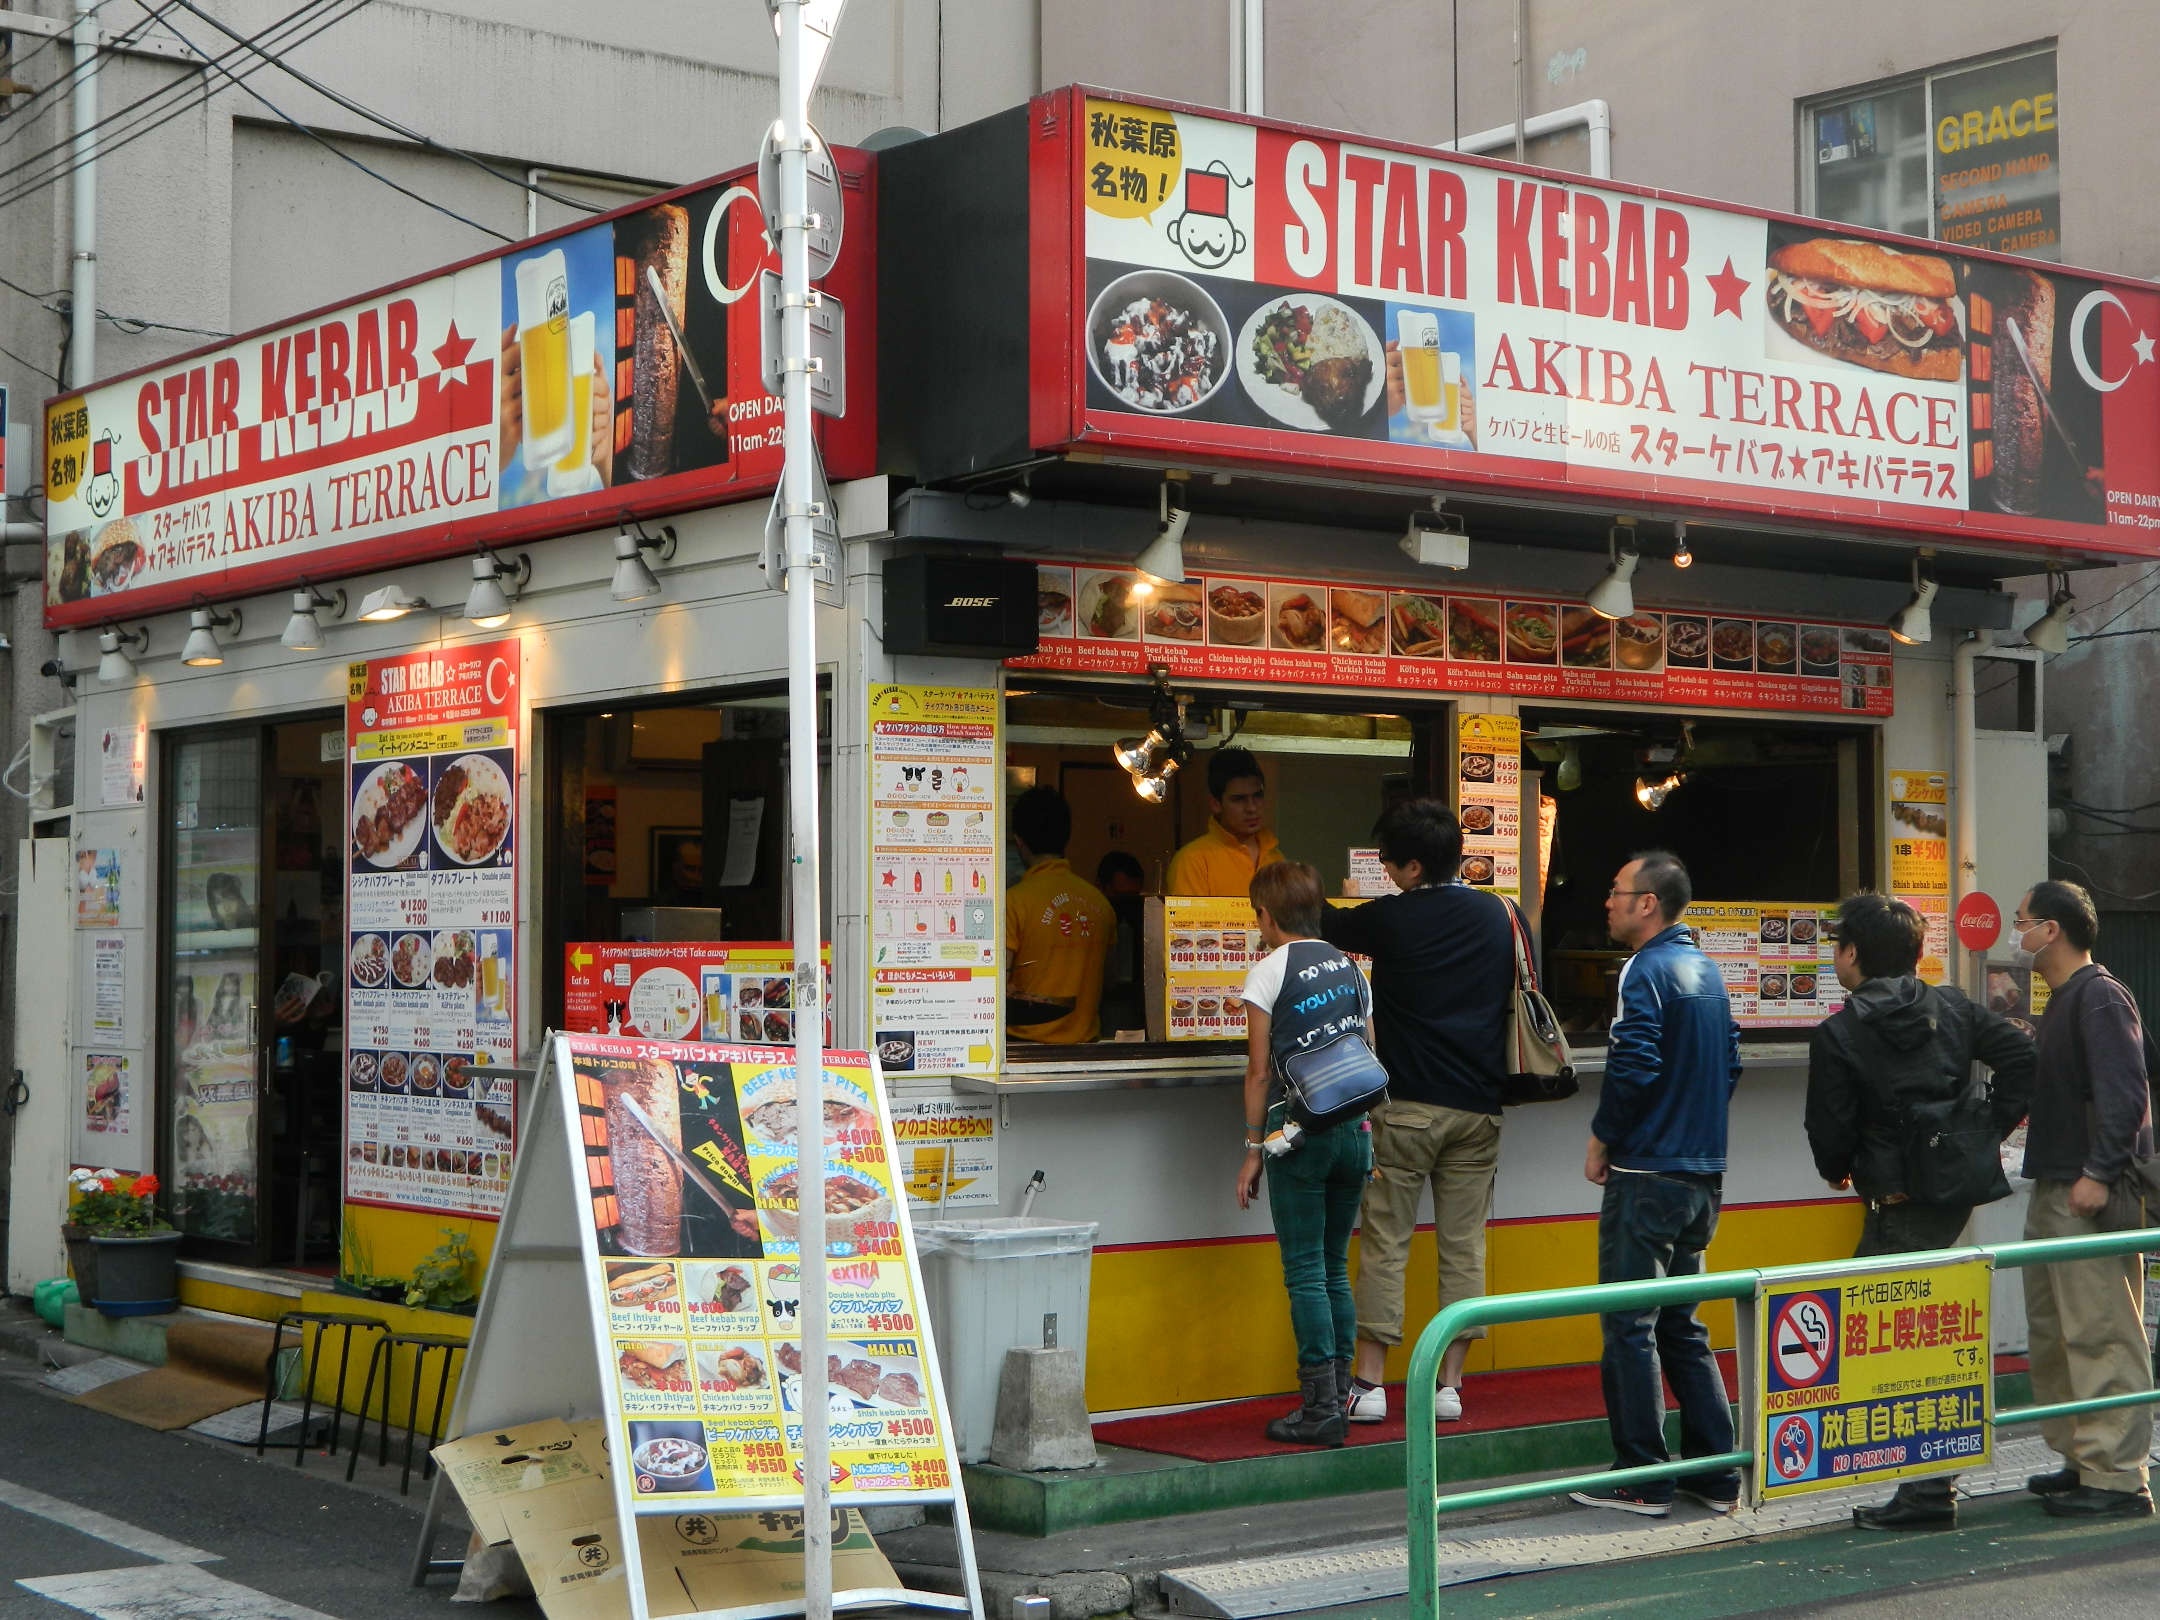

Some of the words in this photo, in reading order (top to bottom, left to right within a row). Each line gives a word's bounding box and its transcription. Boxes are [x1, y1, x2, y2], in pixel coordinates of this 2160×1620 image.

[1937, 93, 2055, 153] GRACE
[1090, 111, 1178, 160] 秋葉原
[1940, 163, 2002, 192] SECOND
[2005, 152, 2050, 177] HAND
[1941, 193, 2008, 221] CAMERA
[1942, 221, 1982, 242] VIDEO
[1987, 208, 2043, 233] CAMERA
[1284, 139, 1468, 300] STAR
[1498, 177, 1690, 331] KEBAB
[2001, 229, 2056, 253] CAMERA
[137, 357, 240, 497] STAR
[261, 297, 419, 456] KEBAB
[1483, 331, 1676, 415] AKIBA
[1689, 361, 1960, 452] TERRACE
[729, 398, 761, 423] OPEN
[51, 406, 88, 446] 秋葉原
[1488, 414, 1621, 455] ケバブと生ビールの店
[221, 483, 316, 556] AKIBA
[328, 440, 492, 527] TERRACE
[2107, 490, 2132, 504] OPEN
[944, 597, 1000, 607] BOSE
[1056, 646, 1073, 655] pita
[1078, 646, 1095, 655] Beef
[1097, 647, 1119, 656] kebab
[1121, 650, 1139, 658] wrap
[1144, 646, 1163, 654] Beef
[1165, 647, 1188, 655] kebab
[1147, 654, 1179, 664] Turkish
[1181, 655, 1204, 664] bread
[1208, 653, 1233, 663] Chicken
[1234, 656, 1252, 664] kebab
[1253, 657, 1266, 666] pita
[1269, 657, 1294, 667] Chicken
[1295, 659, 1313, 668] kebab
[1314, 662, 1327, 670] wrap
[1331, 656, 1363, 666] Chicken
[1365, 658, 1386, 667] kebab
[381, 666, 406, 695] STAR
[409, 660, 445, 690] KEBAB
[1334, 665, 1363, 674] Turkish
[1365, 667, 1386, 675] bread
[1422, 667, 1435, 676] pita
[387, 693, 422, 714] AKIBA
[424, 685, 482, 708] TERRACE
[1496, 761, 1518, 770] ¥650
[1496, 776, 1518, 785] ¥550
[1496, 827, 1518, 837] ¥500
[1895, 844, 1912, 857] 1串
[1914, 841, 1946, 861] ¥500
[1496, 866, 1517, 876] ¥650
[1913, 880, 1930, 889] kebab
[400, 899, 427, 911] ¥1200
[1298, 965, 1319, 983] DO
[1318, 956, 1351, 973] WHA
[1294, 993, 1328, 1014] YOU
[1327, 984, 1357, 1001] LOV
[1339, 1015, 1366, 1032] WHA
[572, 1042, 597, 1051] STAR
[600, 1045, 632, 1055] KEBAB
[742, 1070, 774, 1096] BEEF
[835, 1076, 869, 1104] PITA
[840, 1147, 885, 1163] ¥500
[757, 1161, 799, 1193] CHICKE
[859, 1170, 886, 1197] PITA
[854, 1222, 899, 1238] ¥500
[857, 1240, 902, 1257] ¥400
[832, 1260, 880, 1281] EXTRA
[828, 1291, 854, 1299] Double
[881, 1292, 895, 1300] pita
[1845, 1279, 1932, 1307] 千代田区内は
[829, 1299, 903, 1314] ダブルケバブ
[612, 1313, 630, 1322] Beef
[690, 1315, 707, 1323] Beef
[711, 1314, 736, 1323] kebab
[739, 1316, 760, 1325] wrap
[867, 1314, 914, 1331] ¥500
[1845, 1298, 1984, 1358] 路上喫煙禁止
[867, 1343, 915, 1357] HALAL
[1953, 1346, 1984, 1367] です。
[624, 1392, 660, 1402] Chicken
[702, 1393, 729, 1401] Chicken
[732, 1393, 754, 1401] kebab
[755, 1395, 773, 1404] wrap
[1767, 1391, 1784, 1410] NO
[1786, 1386, 1840, 1407] SMOKING
[858, 1409, 878, 1417] Shish
[880, 1408, 906, 1416] kebab
[908, 1408, 928, 1416] lamb
[1821, 1392, 1982, 1449] 放置自転車禁止
[888, 1417, 934, 1437] ¥500
[743, 1442, 784, 1458] ¥650
[1932, 1434, 1982, 1456] 千代田区
[746, 1458, 787, 1474] ¥550
[911, 1459, 947, 1474] ¥400
[1833, 1455, 1850, 1473] NO
[1853, 1446, 1907, 1471] PARKING
[914, 1474, 949, 1489] ¥150
